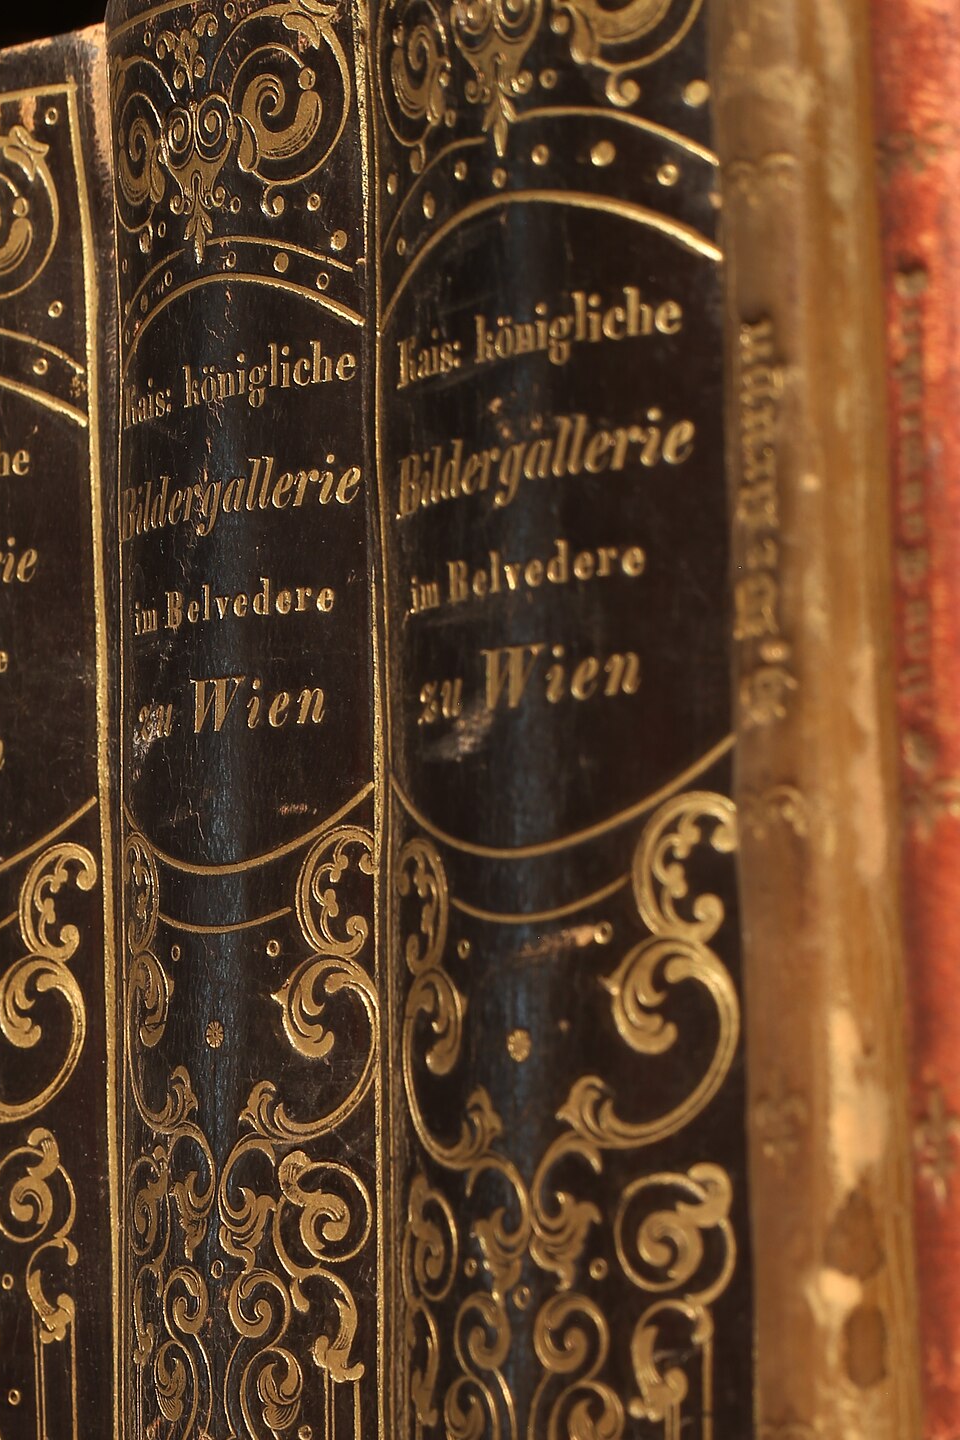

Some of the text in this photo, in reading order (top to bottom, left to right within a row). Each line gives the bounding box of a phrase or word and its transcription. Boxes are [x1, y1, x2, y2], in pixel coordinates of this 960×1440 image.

[474, 287, 683, 366] königliche
[183, 340, 357, 409] königliche
[119, 453, 362, 545] Bildergallerie
[396, 407, 696, 521] Bildergallerie
[165, 577, 336, 631] Belvedere
[409, 539, 646, 614] im Belvedere
[189, 674, 327, 735] Wien
[482, 643, 642, 712] Wien
